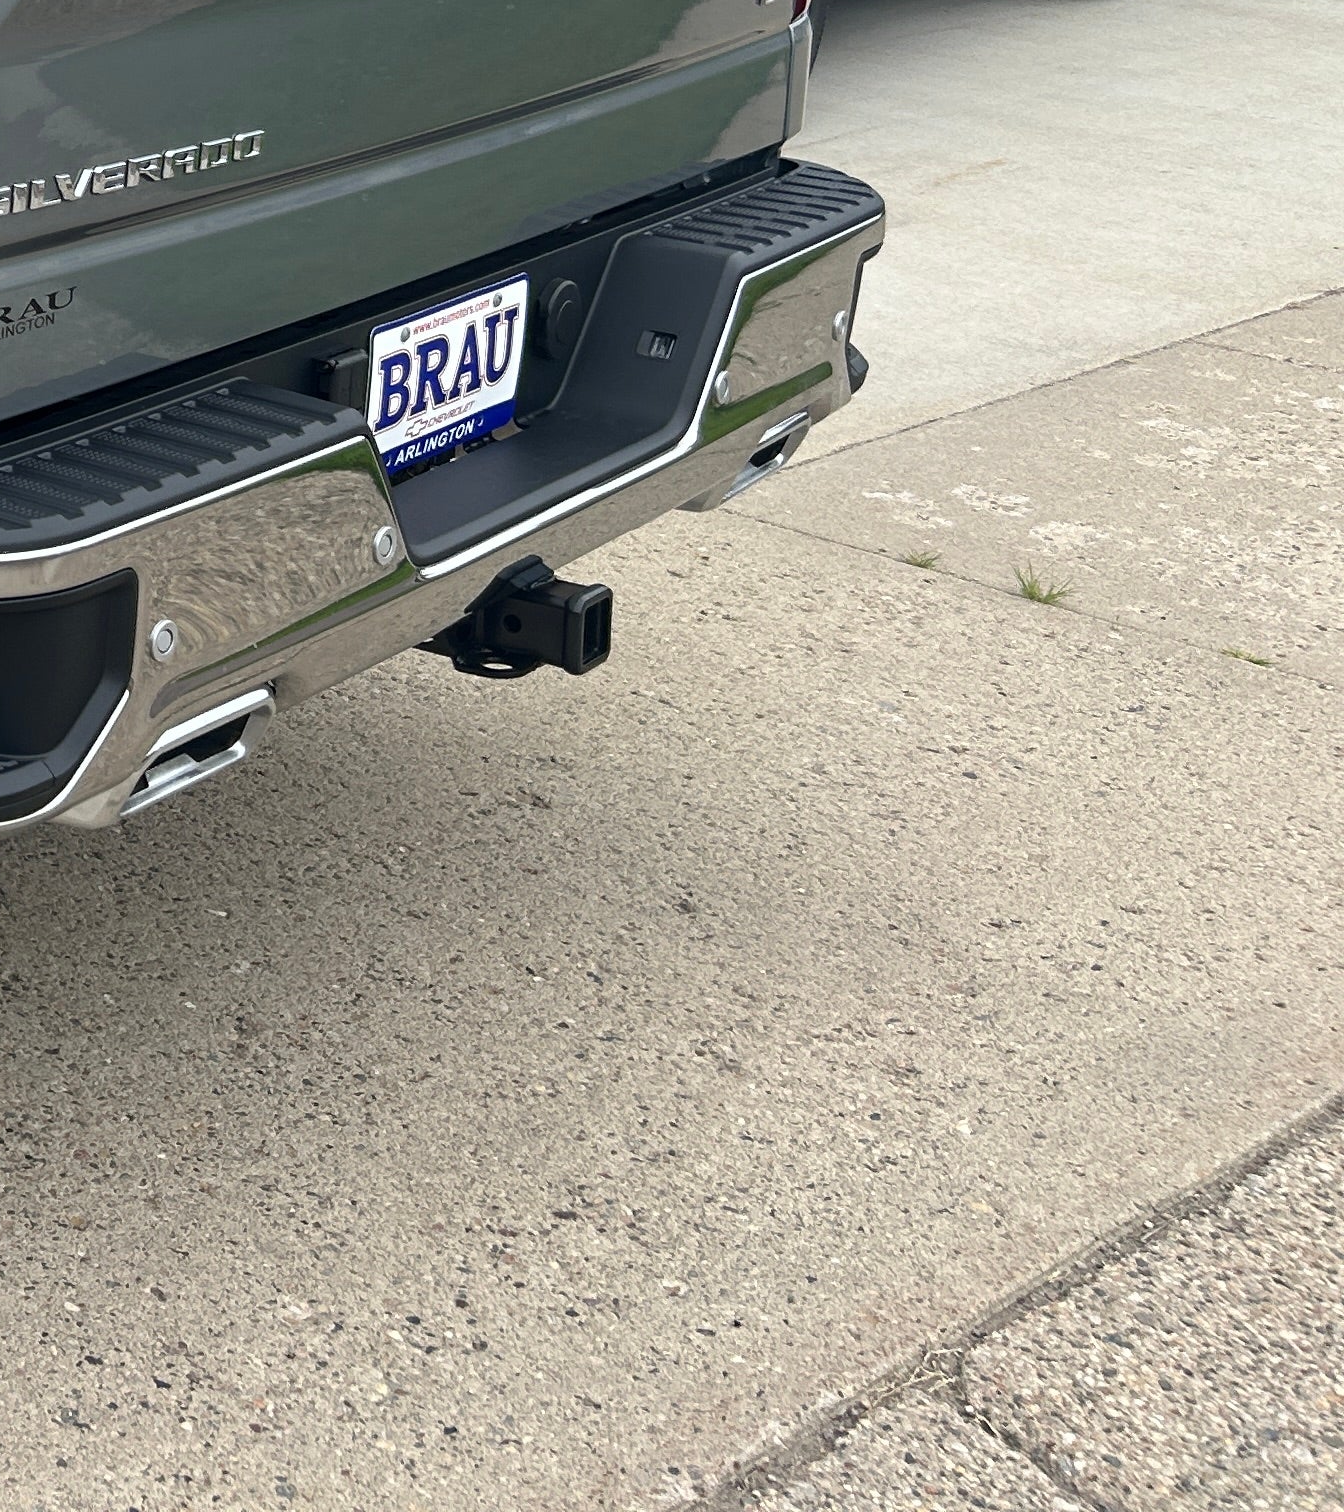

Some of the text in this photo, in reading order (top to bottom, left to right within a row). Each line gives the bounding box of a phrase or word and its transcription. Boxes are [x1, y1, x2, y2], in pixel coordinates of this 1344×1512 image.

[373, 303, 520, 435] BRAU
[427, 400, 475, 427] CHEVROLET
[394, 418, 475, 466] ARLINGTON
